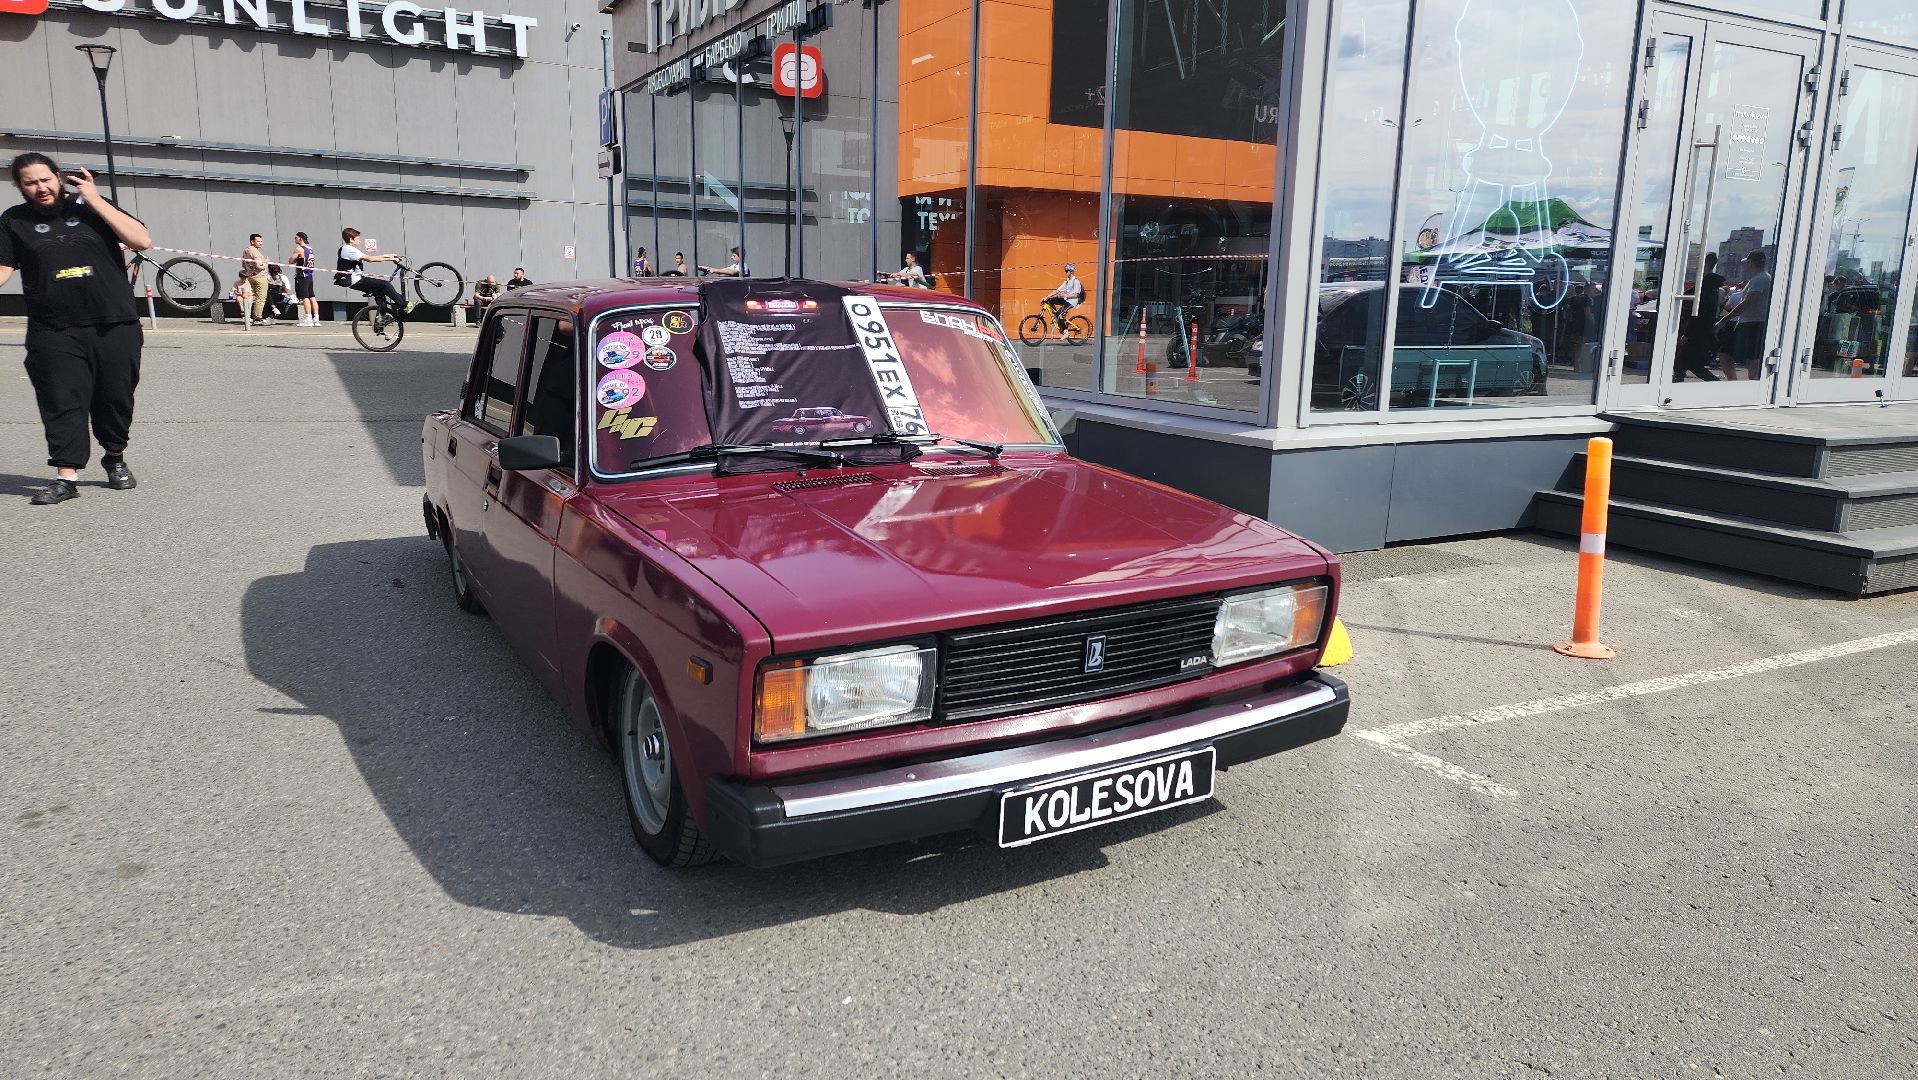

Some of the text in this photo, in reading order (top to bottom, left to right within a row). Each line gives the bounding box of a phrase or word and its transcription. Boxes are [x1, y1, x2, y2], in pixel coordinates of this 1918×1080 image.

[705, 31, 742, 68] БАРБЕКЮ
[622, 387, 640, 398] 92
[1180, 655, 1208, 669] LADA
[1024, 760, 1194, 835] KOLESOVA
